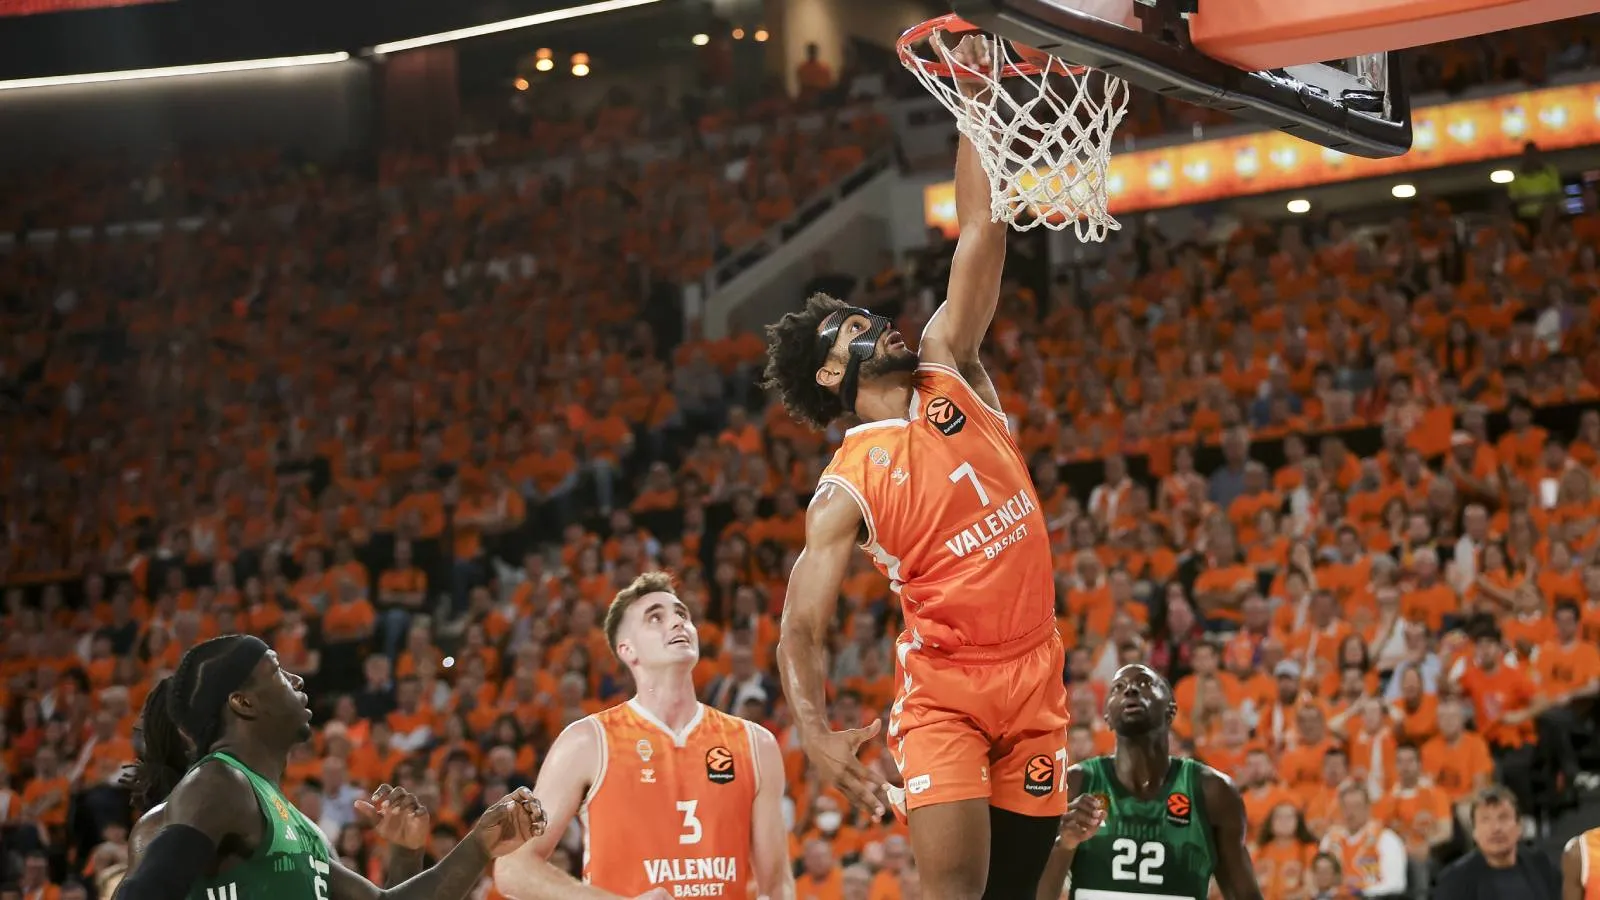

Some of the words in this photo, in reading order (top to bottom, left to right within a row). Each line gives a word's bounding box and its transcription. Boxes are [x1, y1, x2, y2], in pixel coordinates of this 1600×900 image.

[949, 461, 990, 507] 7
[945, 488, 1035, 558] VALENCIA
[983, 523, 1028, 560] BASKET
[676, 799, 703, 844] 3
[643, 856, 737, 884] VALENCIA
[1112, 837, 1165, 885] 22
[673, 882, 725, 898] BASKET
